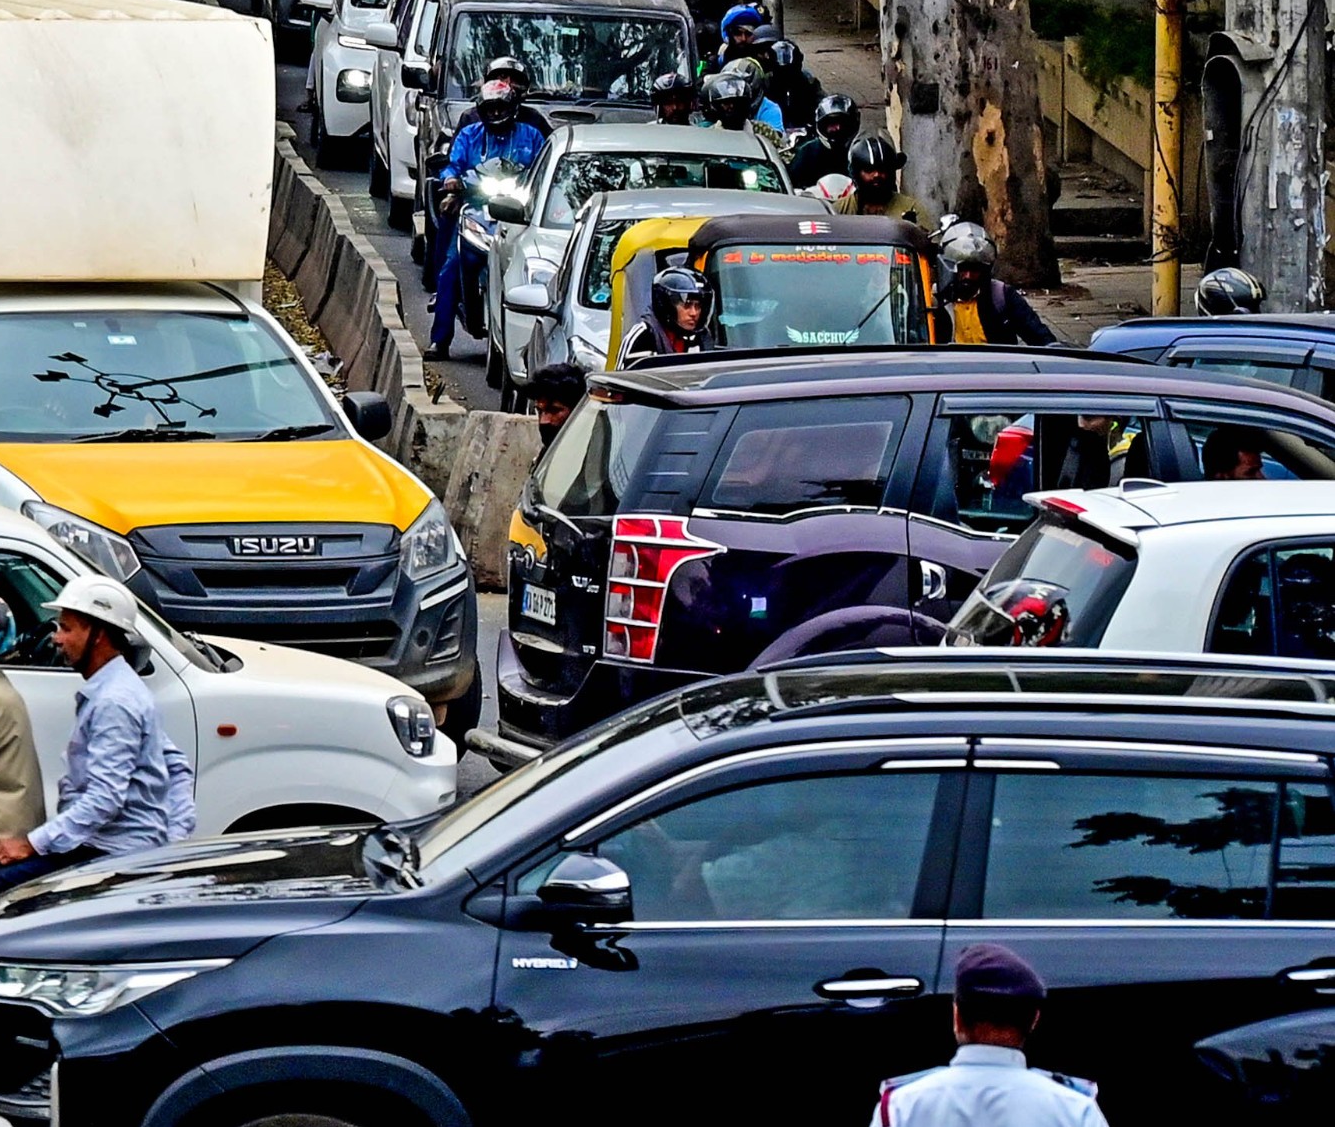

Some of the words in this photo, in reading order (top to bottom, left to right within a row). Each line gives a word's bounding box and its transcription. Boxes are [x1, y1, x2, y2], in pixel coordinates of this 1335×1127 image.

[802, 331, 846, 344] SACCHU
[233, 537, 316, 554] ISUZU
[512, 958, 568, 969] HYBRID
